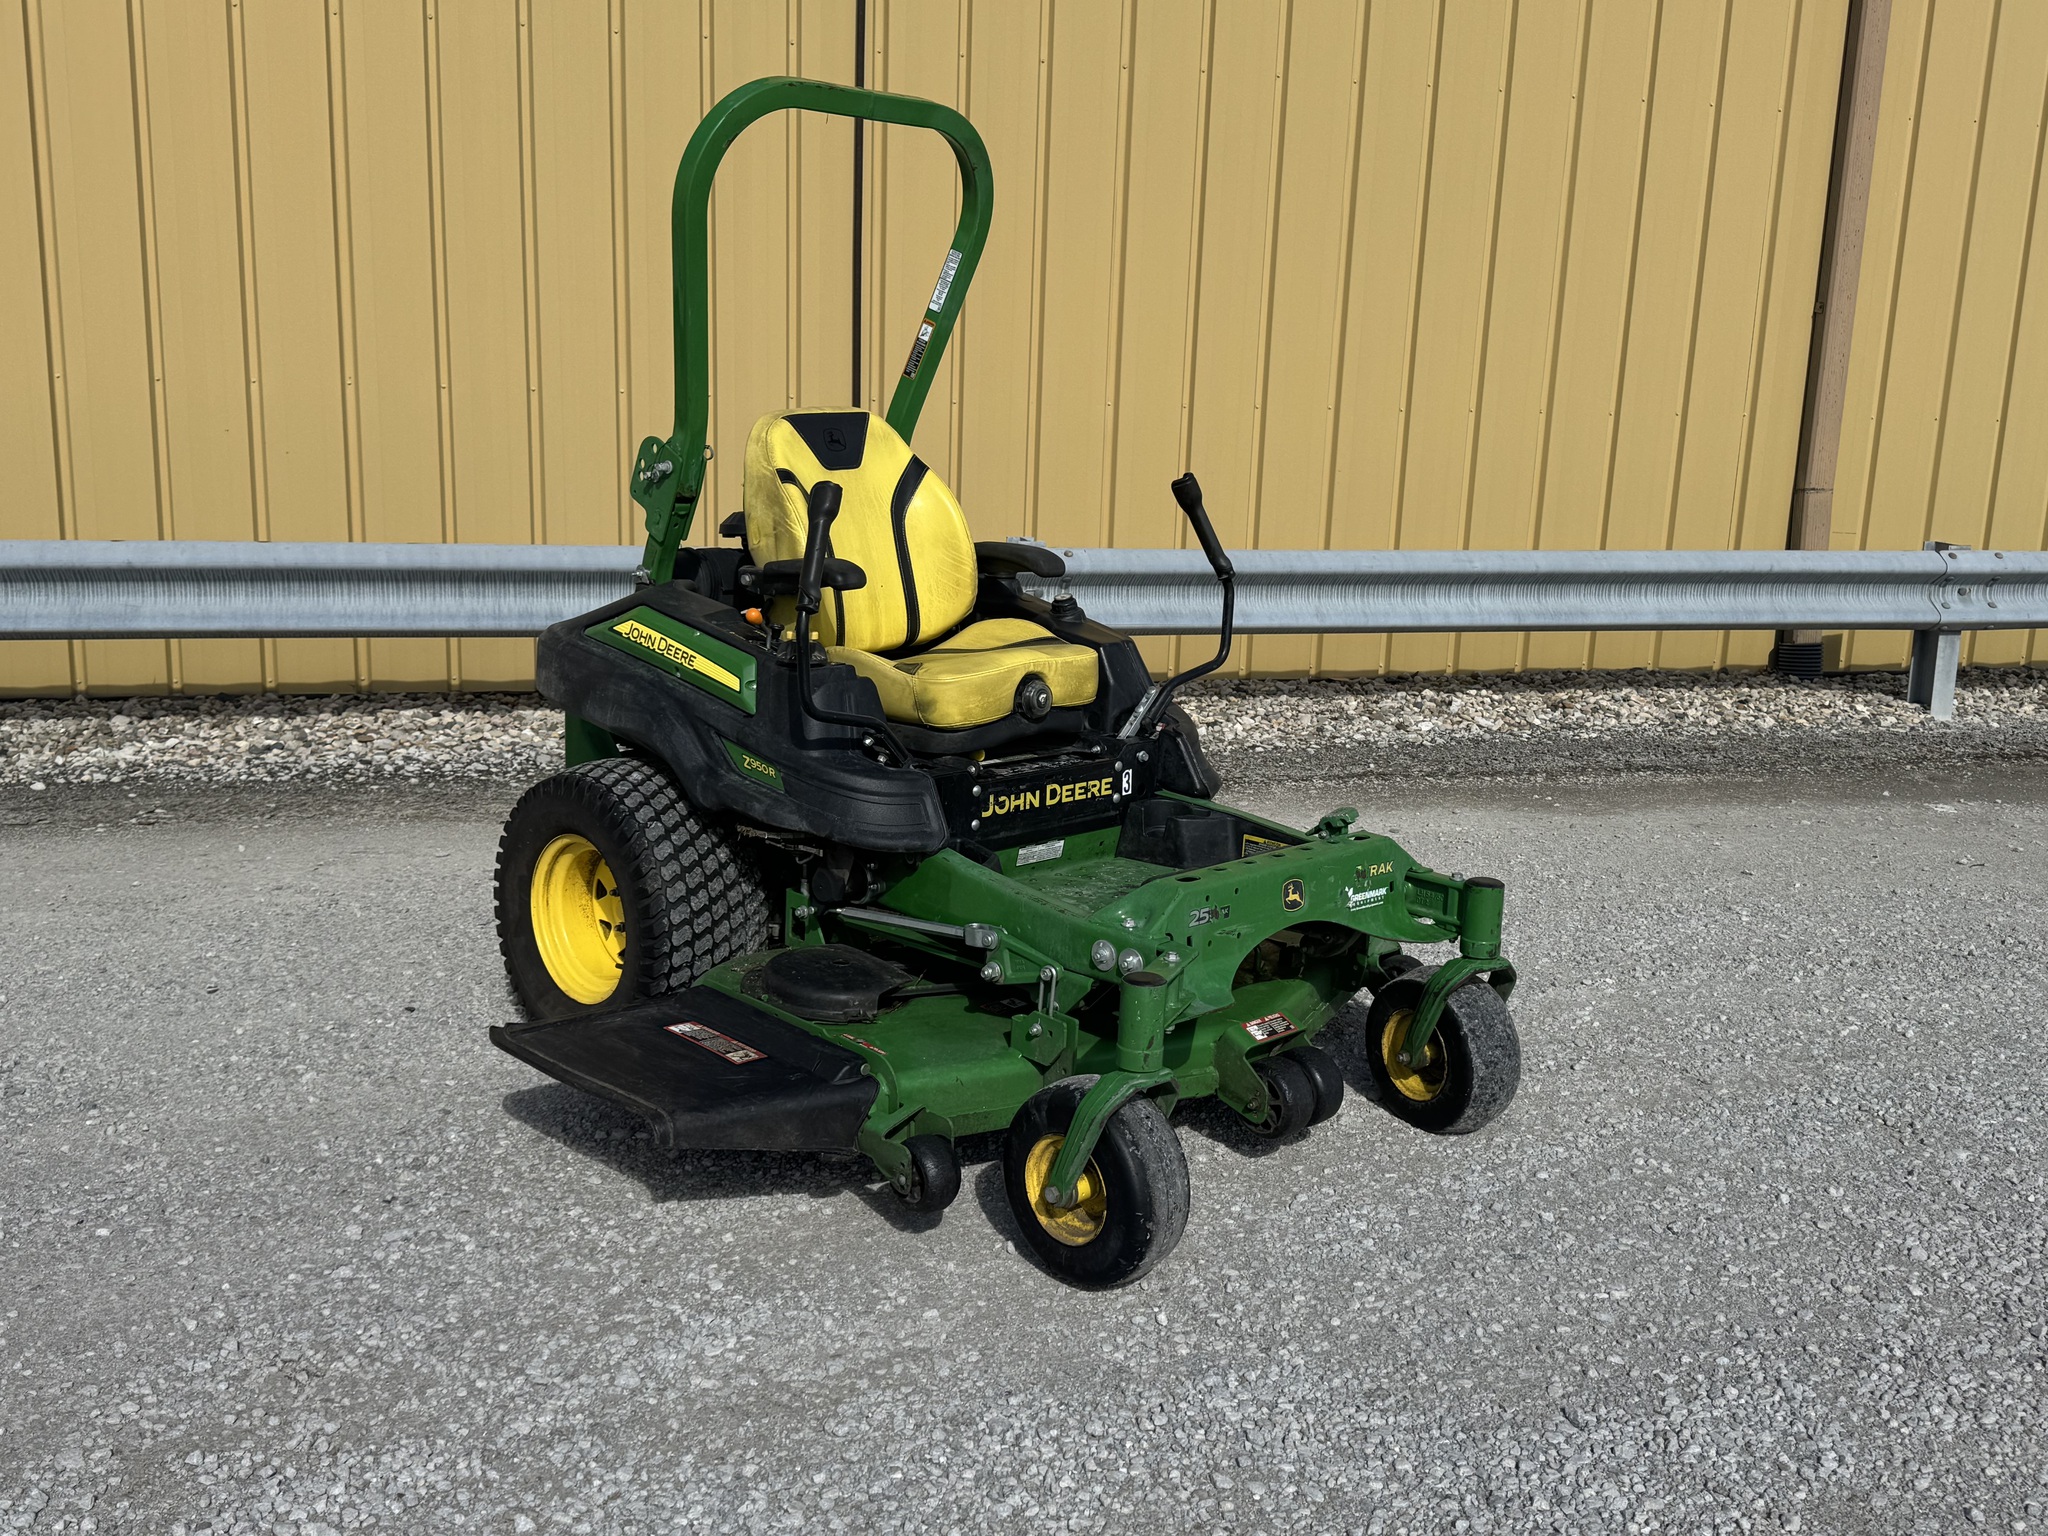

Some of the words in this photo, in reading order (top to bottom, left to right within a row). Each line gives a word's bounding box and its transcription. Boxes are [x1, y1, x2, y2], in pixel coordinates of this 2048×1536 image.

[623, 623, 657, 650] JOHN
[658, 636, 697, 668] DEERE
[742, 754, 776, 778] Z950R
[1123, 770, 1130, 793] 3
[981, 789, 1040, 818] JOHN
[1046, 777, 1113, 806] DEERE
[1350, 887, 1388, 902] GREENMARK
